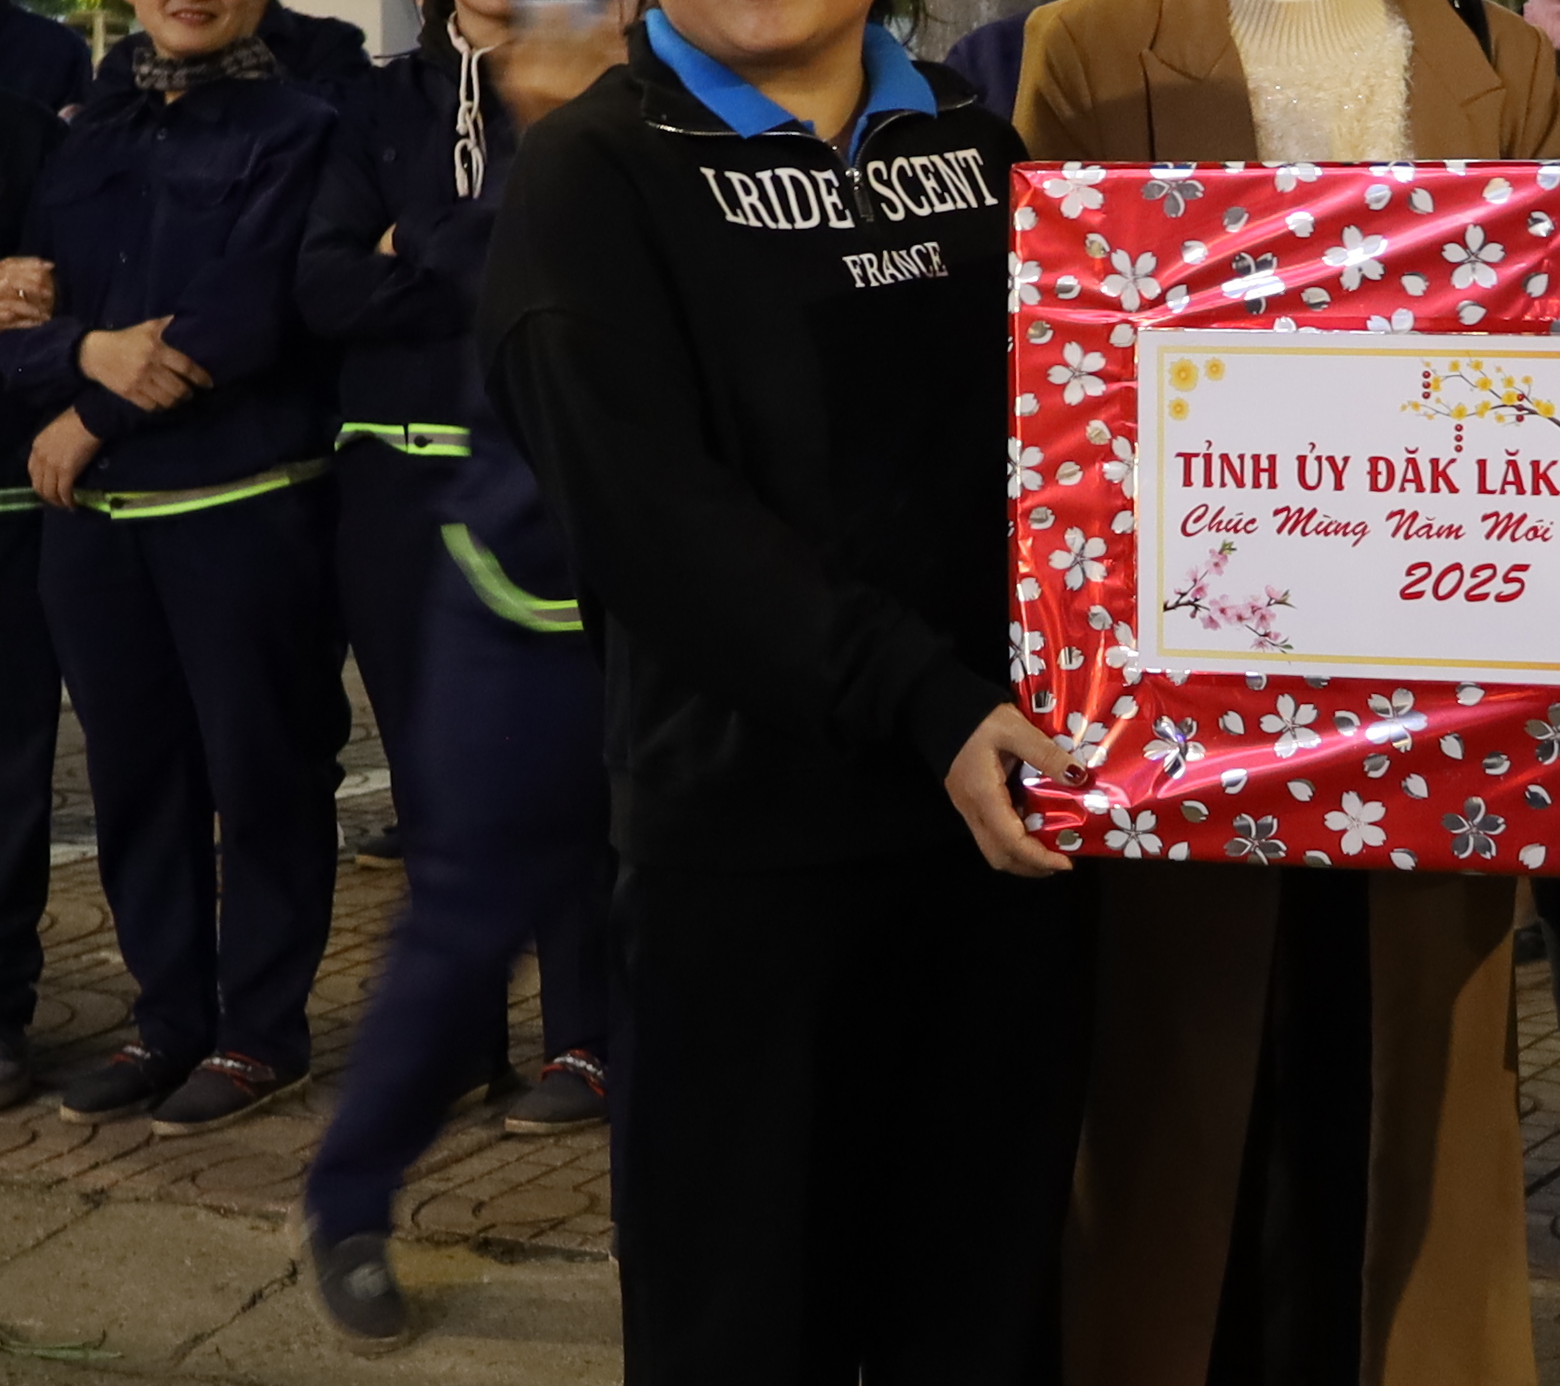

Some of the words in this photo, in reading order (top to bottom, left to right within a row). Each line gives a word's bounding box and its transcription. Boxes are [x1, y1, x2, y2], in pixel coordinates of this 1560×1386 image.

[699, 165, 856, 230] LRIDE
[866, 148, 999, 222] SCENT
[842, 241, 948, 288] FRANCE
[1175, 440, 1279, 489] TỈNH
[1295, 442, 1351, 492] ỦY
[1367, 446, 1461, 494] ĐĂK
[1180, 503, 1259, 538] Chúc
[1272, 505, 1371, 548] Mừng
[1385, 509, 1466, 541] Năm
[1399, 561, 1532, 603] 2025
